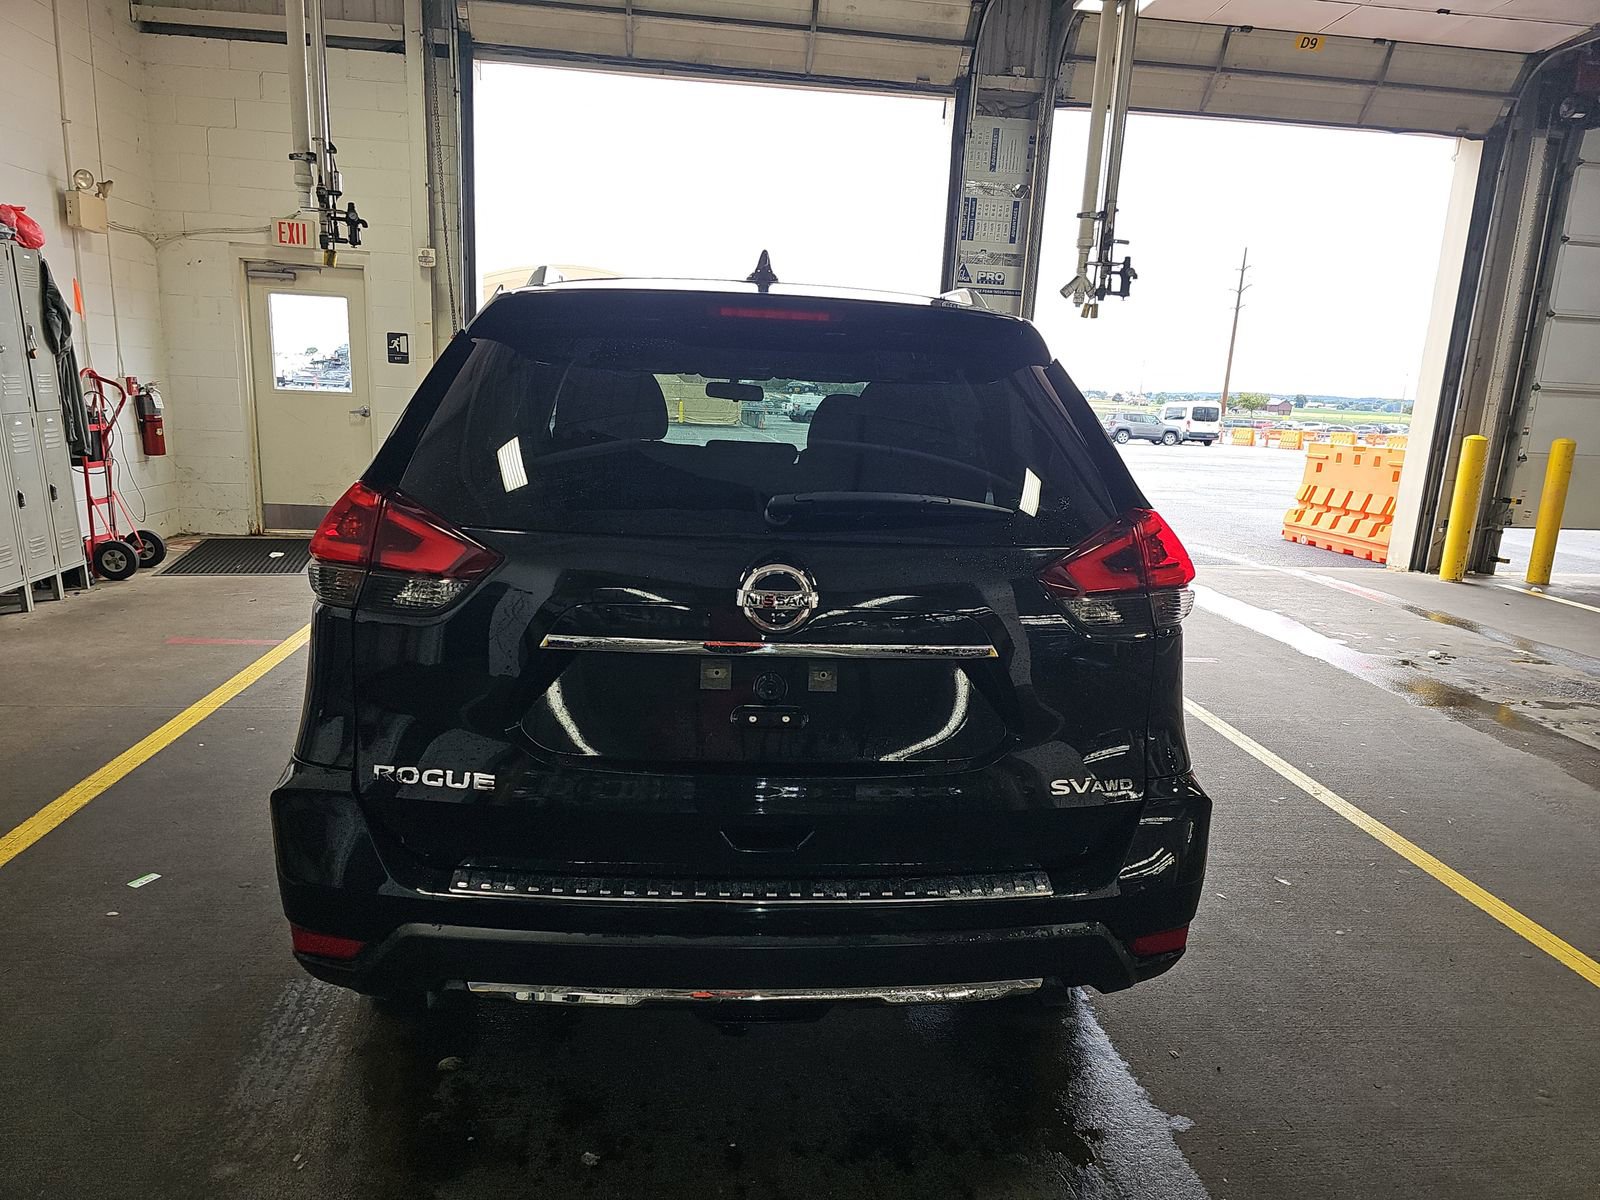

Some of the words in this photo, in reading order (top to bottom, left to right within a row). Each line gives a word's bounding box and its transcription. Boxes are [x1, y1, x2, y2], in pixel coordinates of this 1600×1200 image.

[1300, 36, 1318, 49] D9
[991, 134, 999, 166] ADVANTAGES
[1010, 207, 1019, 238] ADVANTAGES
[977, 271, 1005, 281] PRO
[745, 593, 809, 607] NISSAN
[373, 764, 496, 790] ROGUE
[1050, 777, 1092, 796] SV
[1090, 778, 1133, 793] AWD
